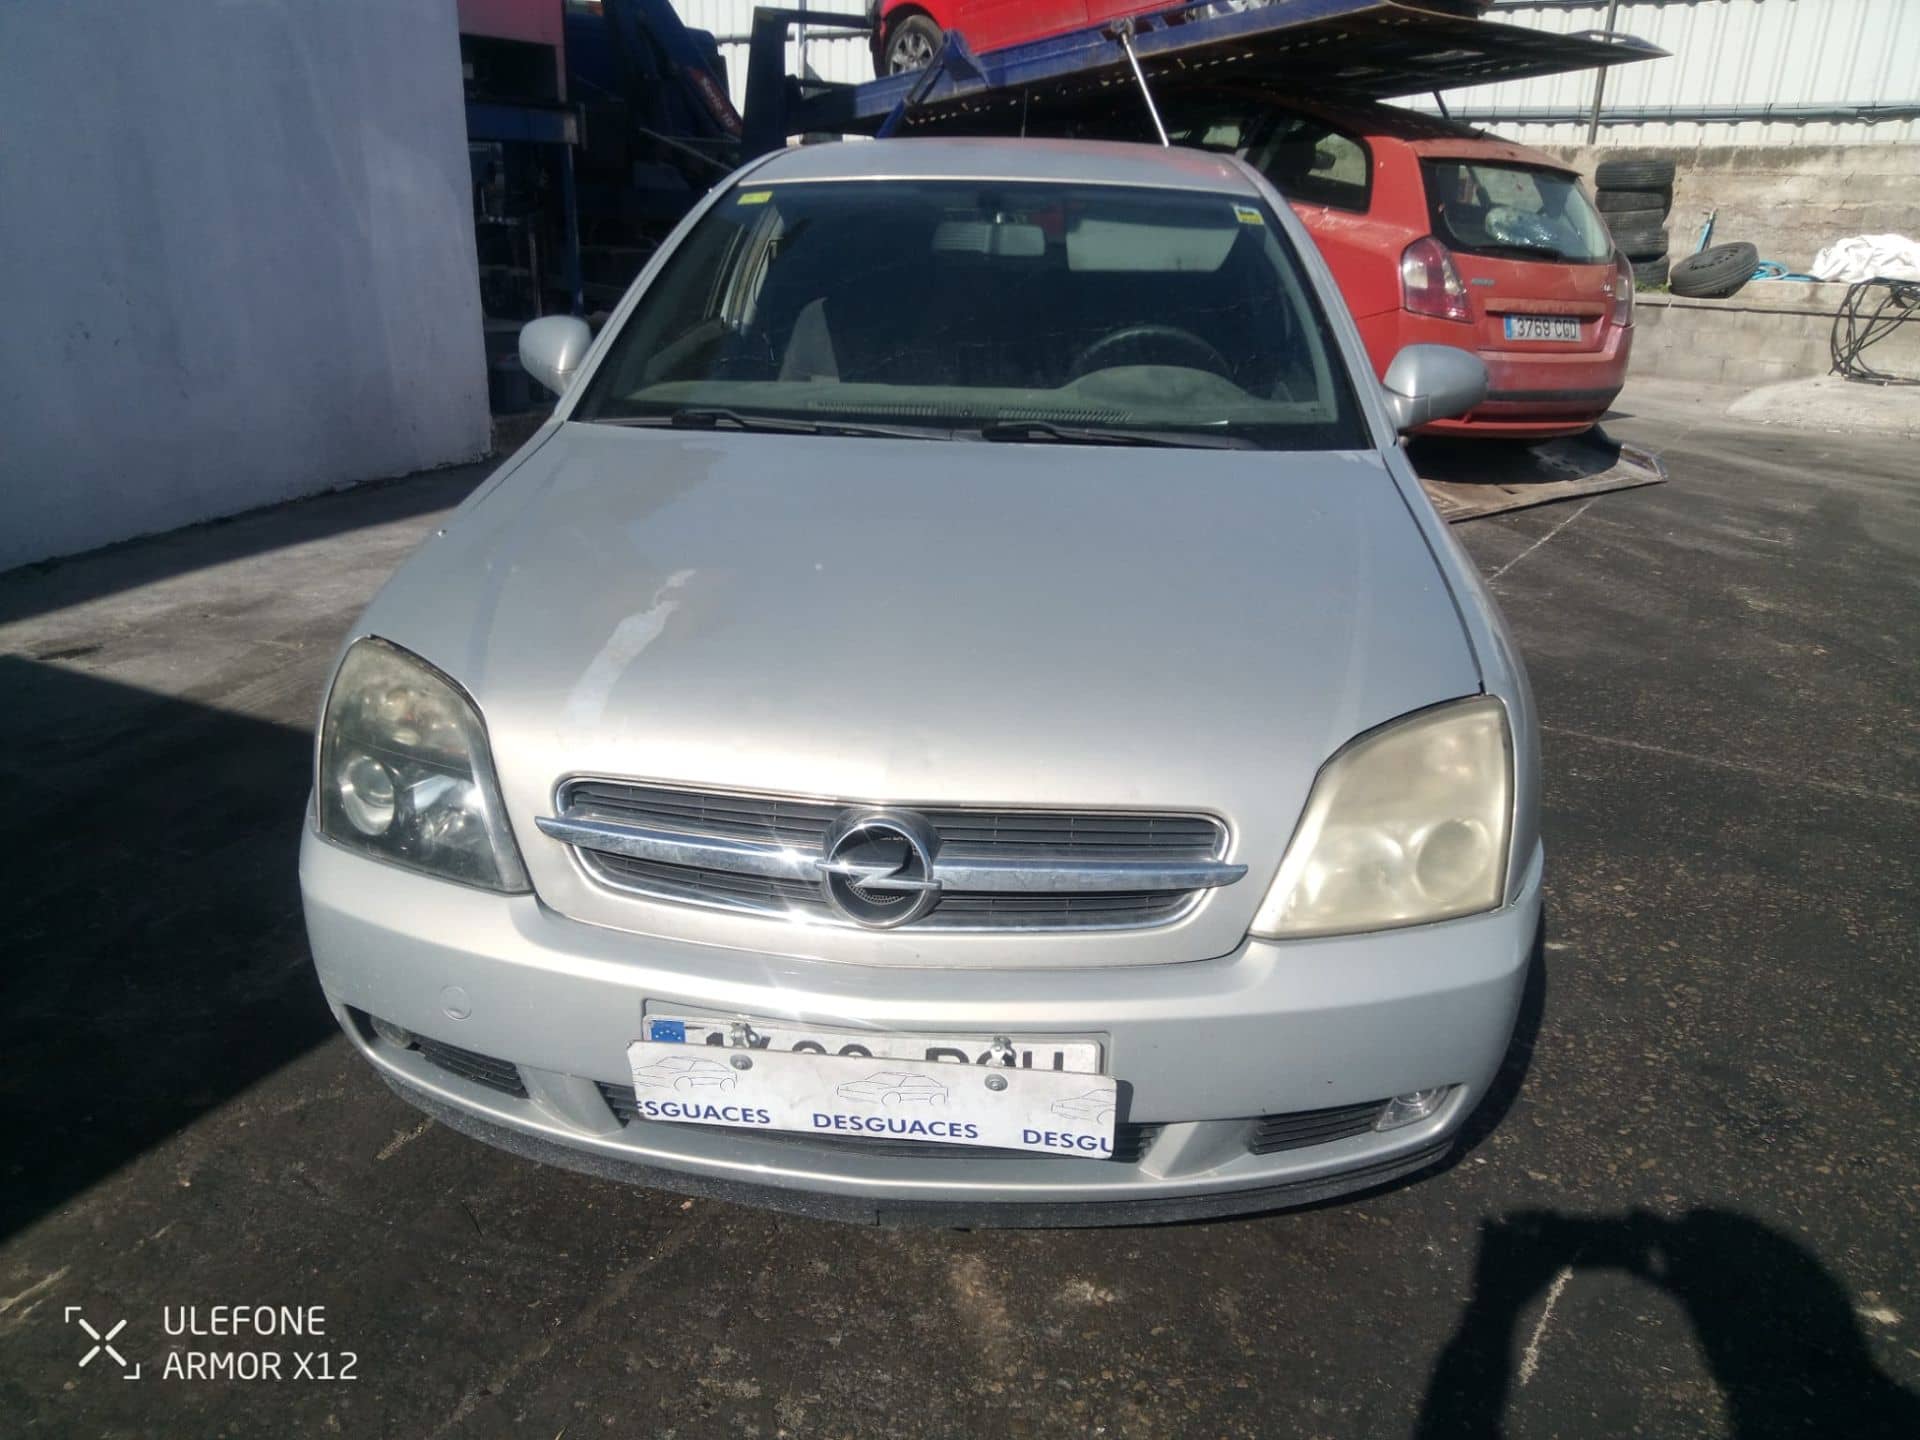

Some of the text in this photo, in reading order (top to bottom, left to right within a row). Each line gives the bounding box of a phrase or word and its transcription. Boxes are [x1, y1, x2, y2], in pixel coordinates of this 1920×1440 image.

[1517, 317, 1577, 339] 3769 CGD
[812, 1113, 979, 1139] DESGUACES
